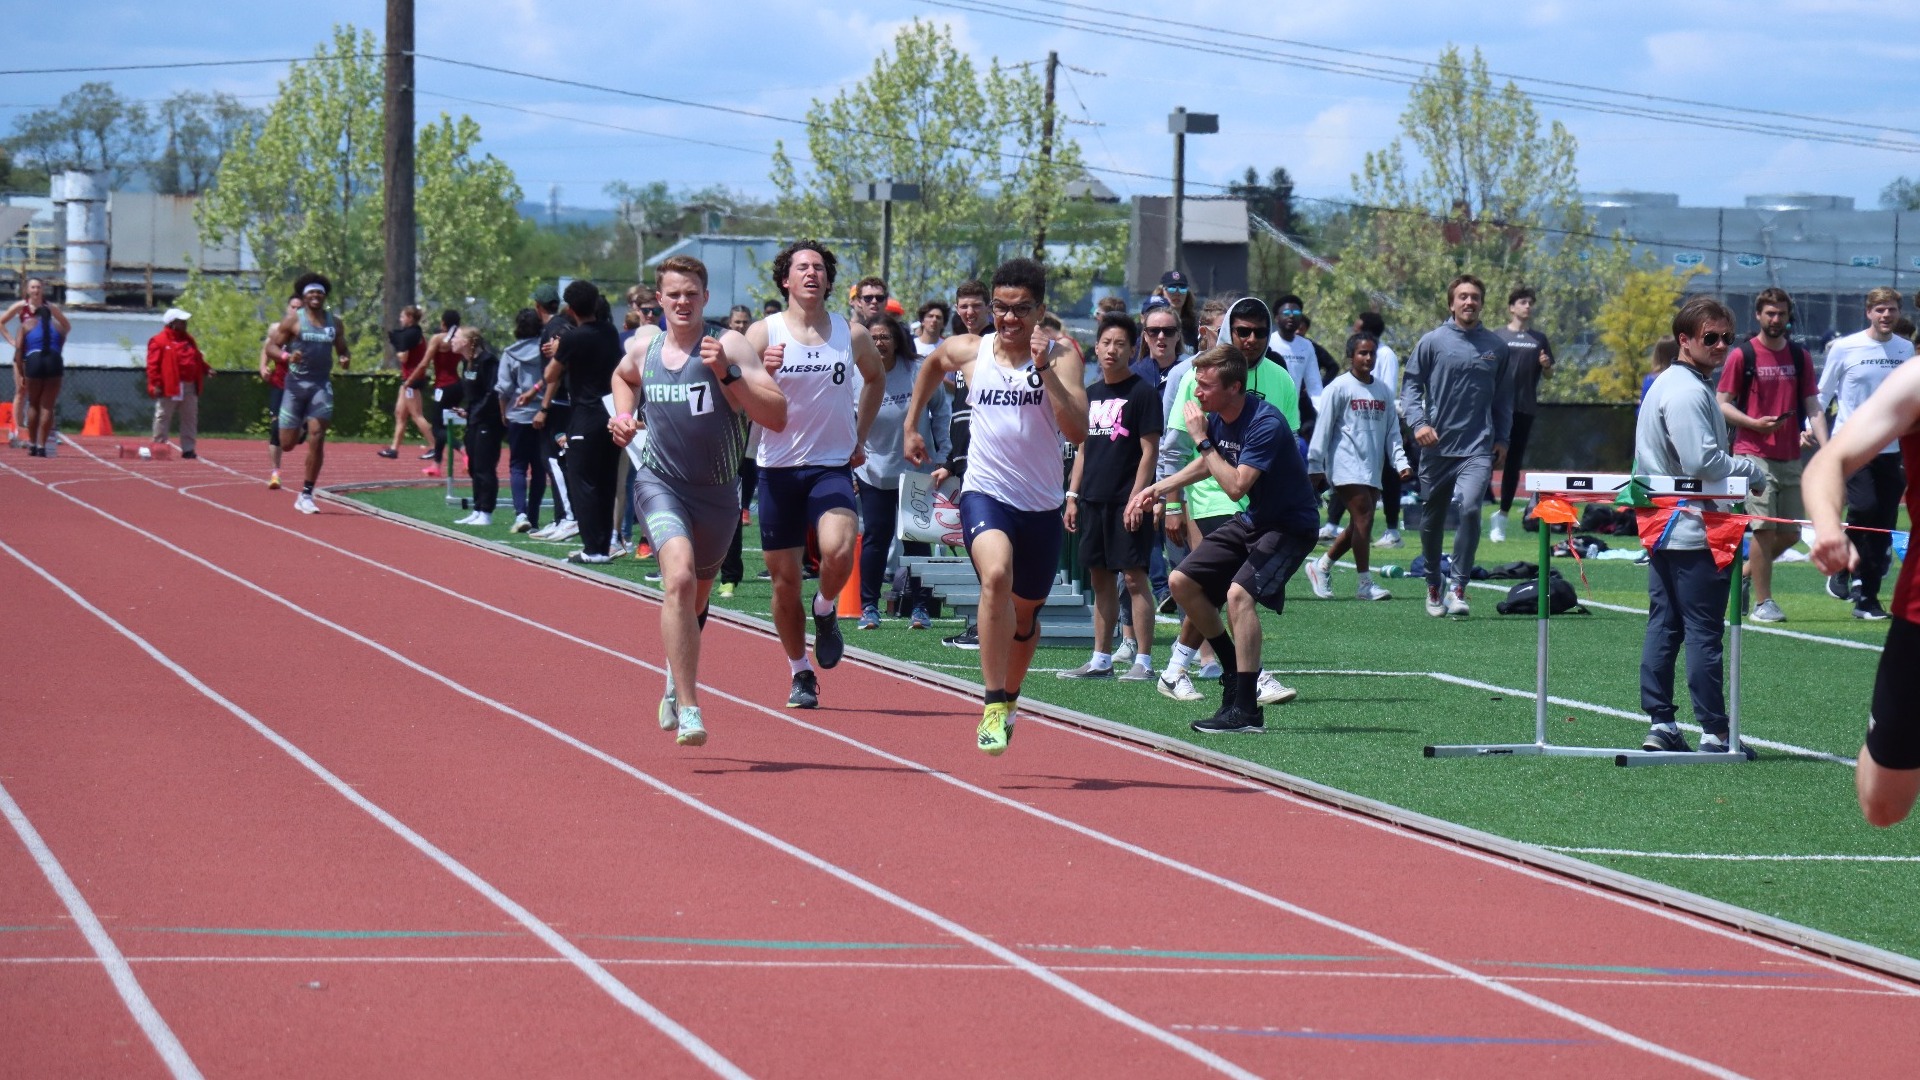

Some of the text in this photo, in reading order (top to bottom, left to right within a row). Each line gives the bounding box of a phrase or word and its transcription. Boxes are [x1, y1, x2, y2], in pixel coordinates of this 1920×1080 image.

[780, 364, 832, 373] MESSIA
[832, 361, 846, 385] 8
[690, 385, 706, 412] 7
[978, 389, 1044, 406] MESSIAH
[911, 481, 930, 529] GOT
